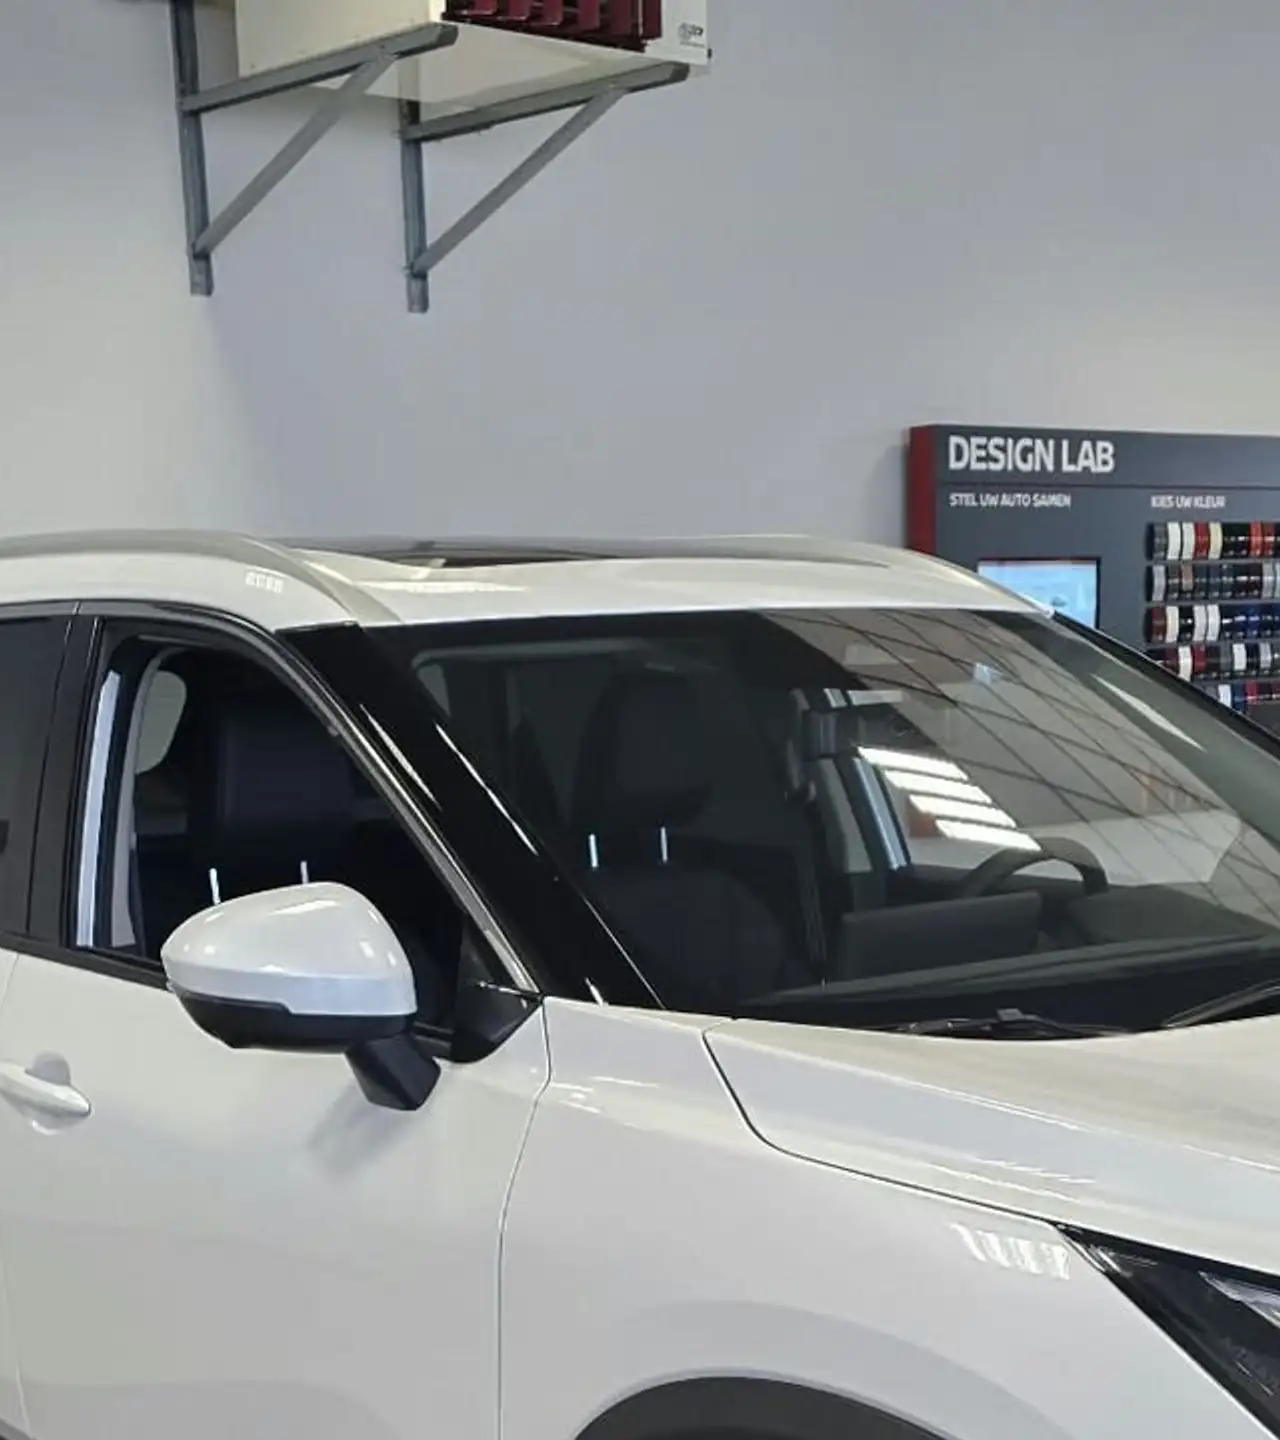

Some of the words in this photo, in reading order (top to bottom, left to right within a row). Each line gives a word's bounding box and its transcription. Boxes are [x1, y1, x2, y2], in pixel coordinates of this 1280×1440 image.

[948, 434, 1055, 473] DESIGN
[1061, 438, 1116, 474] LAB
[949, 491, 978, 508] STEL
[1000, 493, 1032, 508] AUTO
